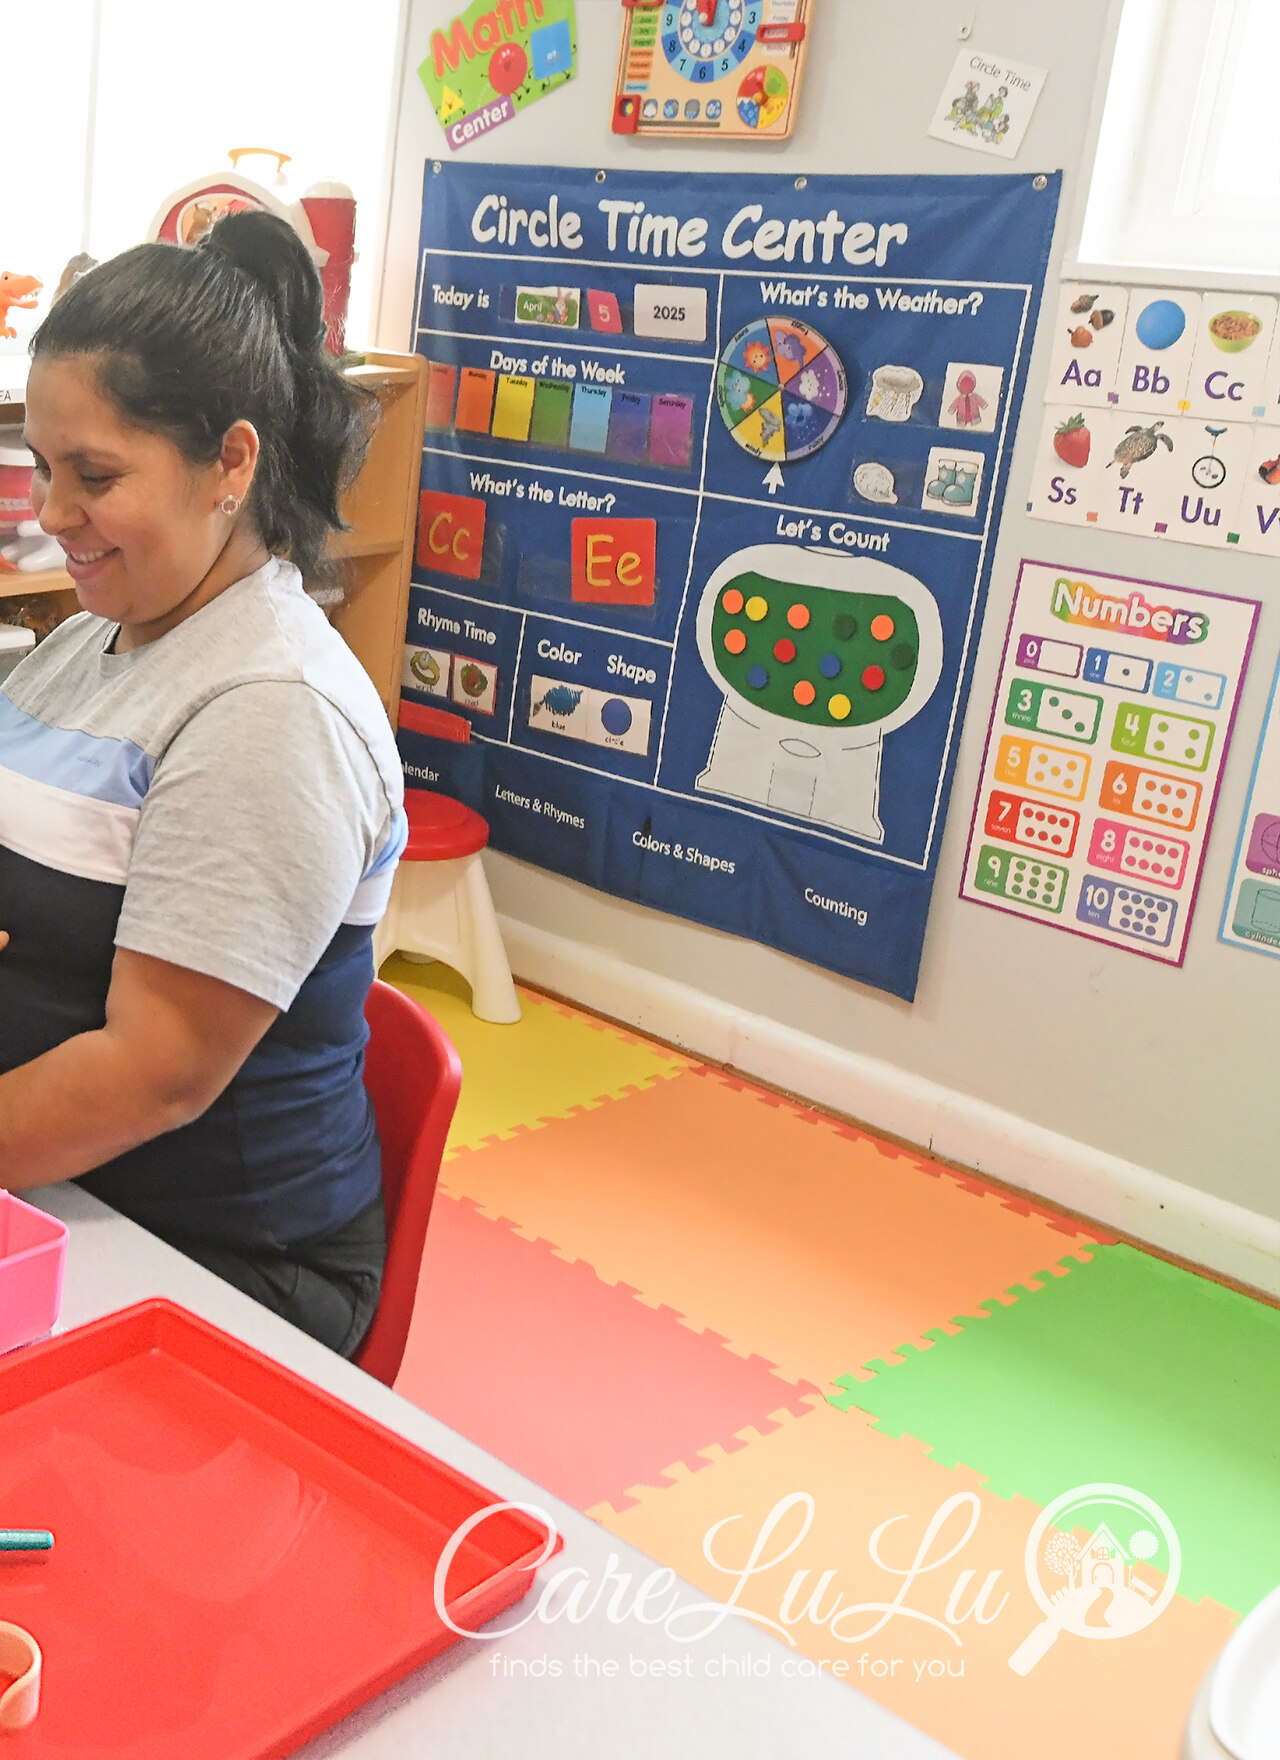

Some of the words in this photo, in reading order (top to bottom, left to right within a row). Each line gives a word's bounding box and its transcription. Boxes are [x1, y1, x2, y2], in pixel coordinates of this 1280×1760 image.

[666, 13, 674, 27] 9
[749, 11, 756, 24] 3
[669, 40, 676, 53] 8
[738, 39, 746, 52] 4
[680, 59, 687, 71] 7
[699, 67, 706, 80] 6
[721, 59, 729, 71] 5
[969, 56, 1001, 78] Circle
[1005, 69, 1031, 91] Time
[451, 101, 509, 144] Center
[471, 194, 584, 249] Circle
[598, 198, 710, 259] Time
[722, 203, 909, 268] Center
[432, 284, 473, 310] Today
[477, 288, 490, 308] is
[523, 301, 543, 312] April
[760, 281, 828, 308] What's
[834, 285, 869, 310] the
[875, 288, 984, 316] Weather?
[598, 304, 611, 323] 5
[653, 306, 686, 321] 2025
[490, 350, 527, 375] Days
[531, 355, 549, 376] of
[551, 357, 576, 379] the
[581, 361, 625, 384] Week
[1060, 359, 1102, 387] Aa
[506, 377, 528, 388] Tuesday
[538, 379, 570, 394] Wednesday
[1132, 365, 1170, 394] Bb
[1204, 371, 1245, 401] Cc
[580, 385, 607, 398] Thursday
[658, 397, 687, 410] Saturday
[745, 443, 762, 455] windy
[470, 472, 524, 498] What's
[528, 481, 554, 503] the
[559, 486, 616, 513] Letter?
[1047, 476, 1077, 505] Ss
[1119, 486, 1144, 515] Tt
[1181, 495, 1221, 526] Uu
[1257, 505, 1280, 534] V
[429, 512, 470, 561] Cc
[776, 514, 822, 541] Let's
[828, 522, 891, 552] Count
[586, 534, 642, 587] Ee
[1054, 583, 1206, 640] Numbers
[417, 607, 461, 634] Rhyme
[464, 619, 497, 645] Time
[537, 639, 583, 665] Color
[1026, 640, 1038, 658] 0
[607, 654, 657, 684] Shape
[1094, 654, 1102, 671] 1
[1163, 670, 1175, 687] 2
[1017, 689, 1033, 711] 3
[551, 720, 566, 730] blue
[1012, 712, 1032, 723] three
[1125, 712, 1140, 737] 4
[1007, 746, 1021, 767] 5
[401, 761, 440, 782] lendar
[1112, 772, 1128, 795] 6
[495, 784, 530, 809] Letters
[532, 798, 542, 813] &
[543, 802, 585, 829] Rhymes
[999, 800, 1013, 822] 7
[991, 823, 1012, 834] seven
[1100, 829, 1116, 852] 8
[632, 831, 671, 855] Colors
[673, 843, 683, 860] &
[685, 848, 736, 874] Shapes
[1095, 852, 1116, 864] eight
[988, 855, 1002, 878] 9
[805, 888, 868, 927] Counting
[1085, 885, 1110, 910] 10
